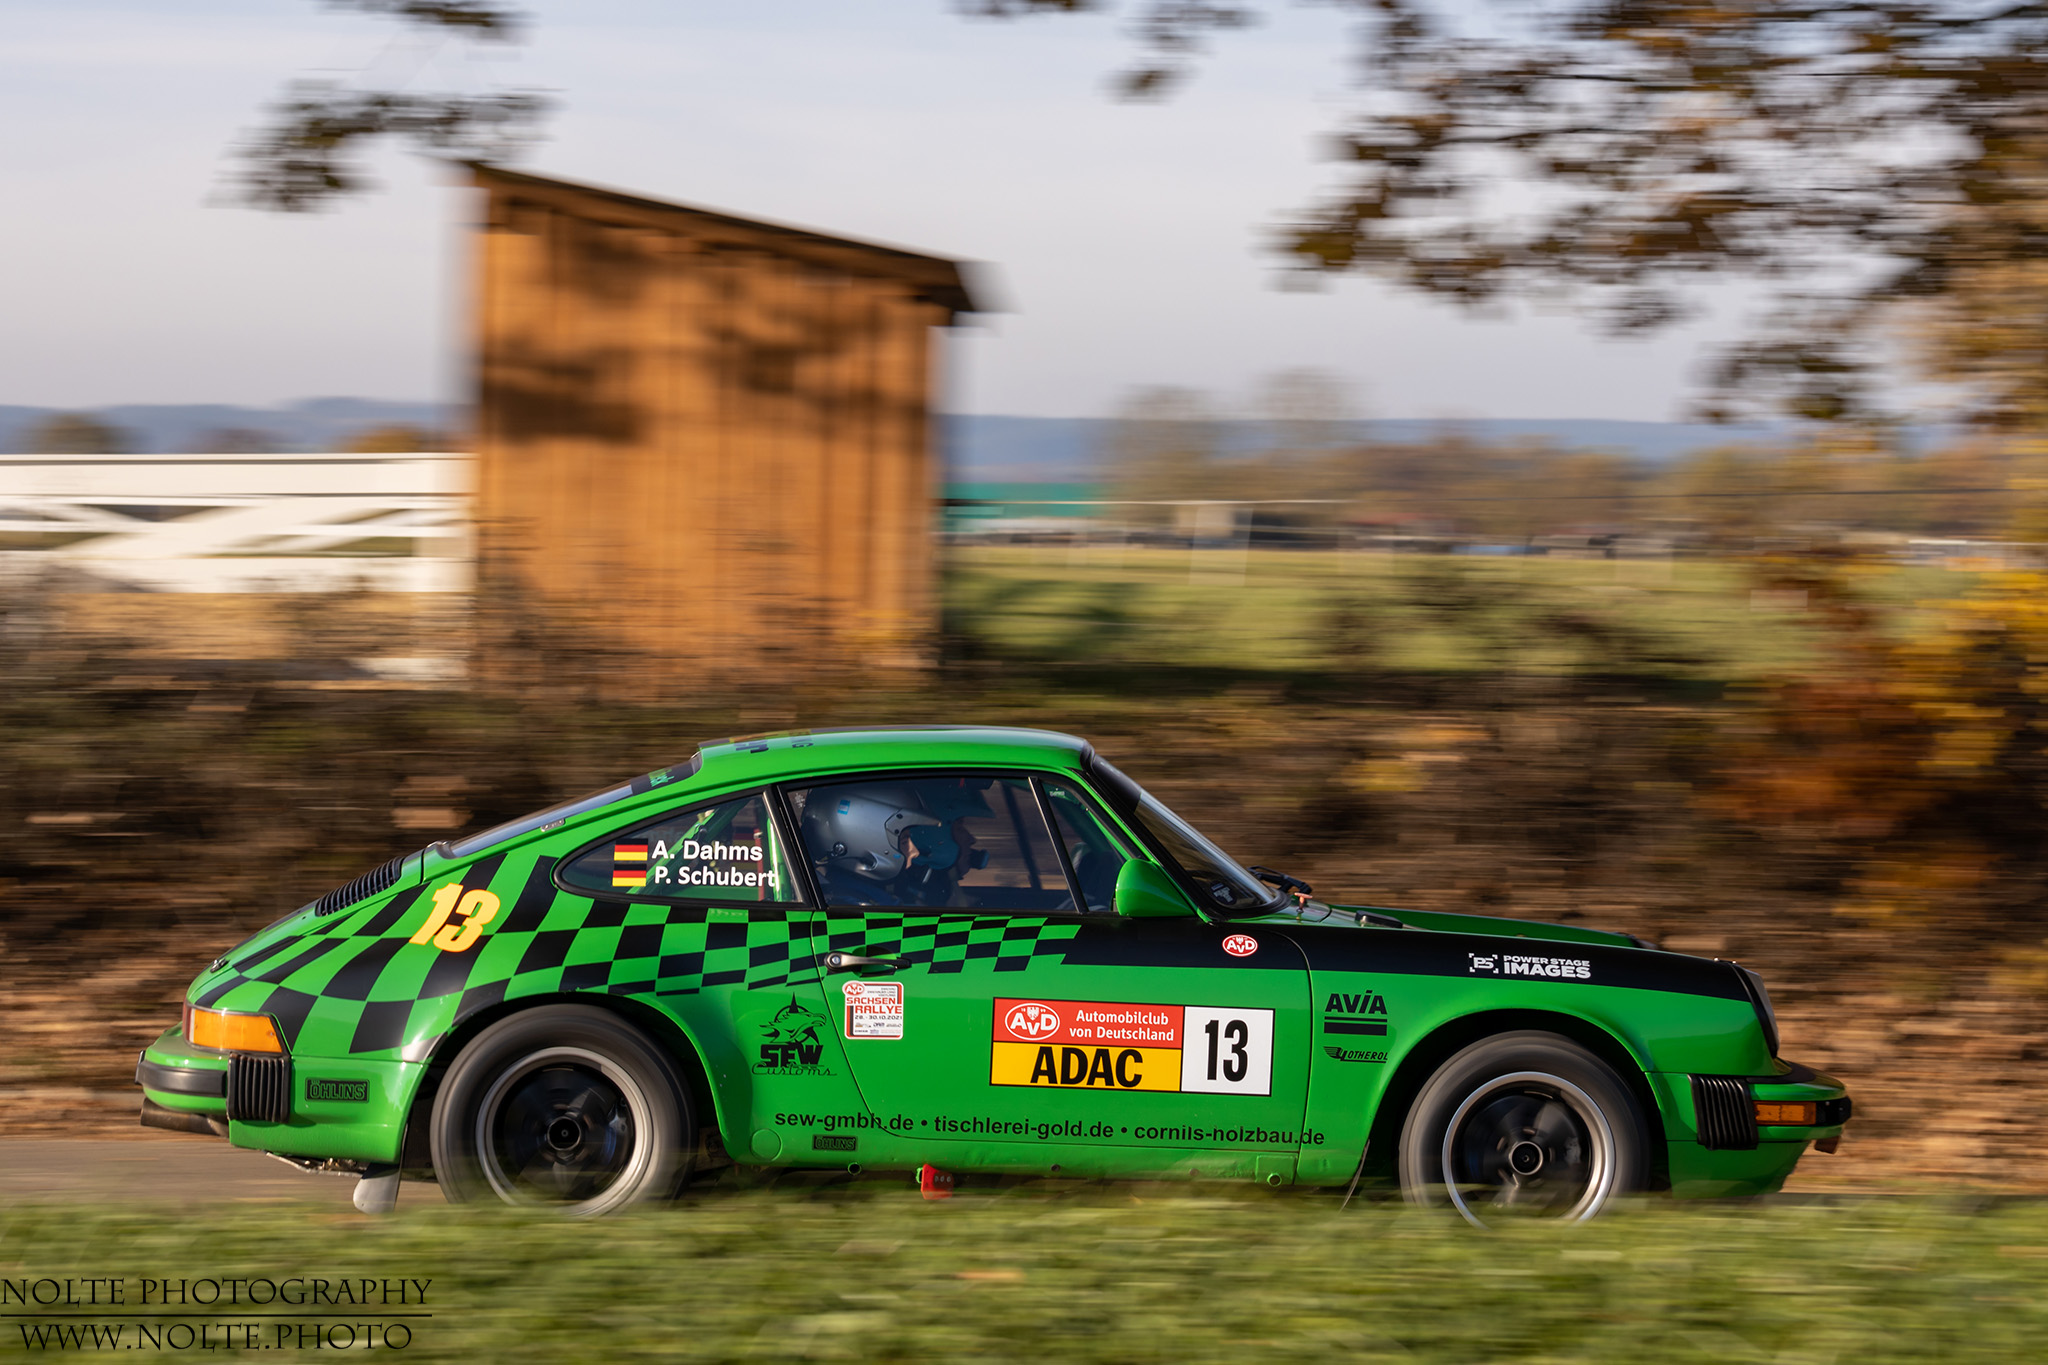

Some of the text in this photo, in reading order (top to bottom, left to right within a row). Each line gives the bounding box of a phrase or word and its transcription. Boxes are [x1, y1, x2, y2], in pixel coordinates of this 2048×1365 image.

[651, 840, 763, 861] A. Dahms
[654, 866, 775, 887] P. Schubert
[408, 882, 501, 953] 13
[1503, 955, 1591, 967] POWER STAGE
[1503, 962, 1592, 979] IMAGES
[846, 997, 896, 1005] SACHSEN
[855, 1005, 902, 1014] RALLYE
[1076, 1009, 1169, 1026] Automobilclub
[1069, 1026, 1174, 1041] von Deutschland
[760, 1044, 824, 1068] SEW
[1204, 1019, 1249, 1082] 13
[752, 1062, 837, 1076] Customs
[1030, 1046, 1143, 1088] ADAC
[310, 1080, 366, 1100] ÖHLINS
[774, 1111, 914, 1131] sew-gmbh.de
[934, 1115, 1114, 1139] tischlerei-gold.de
